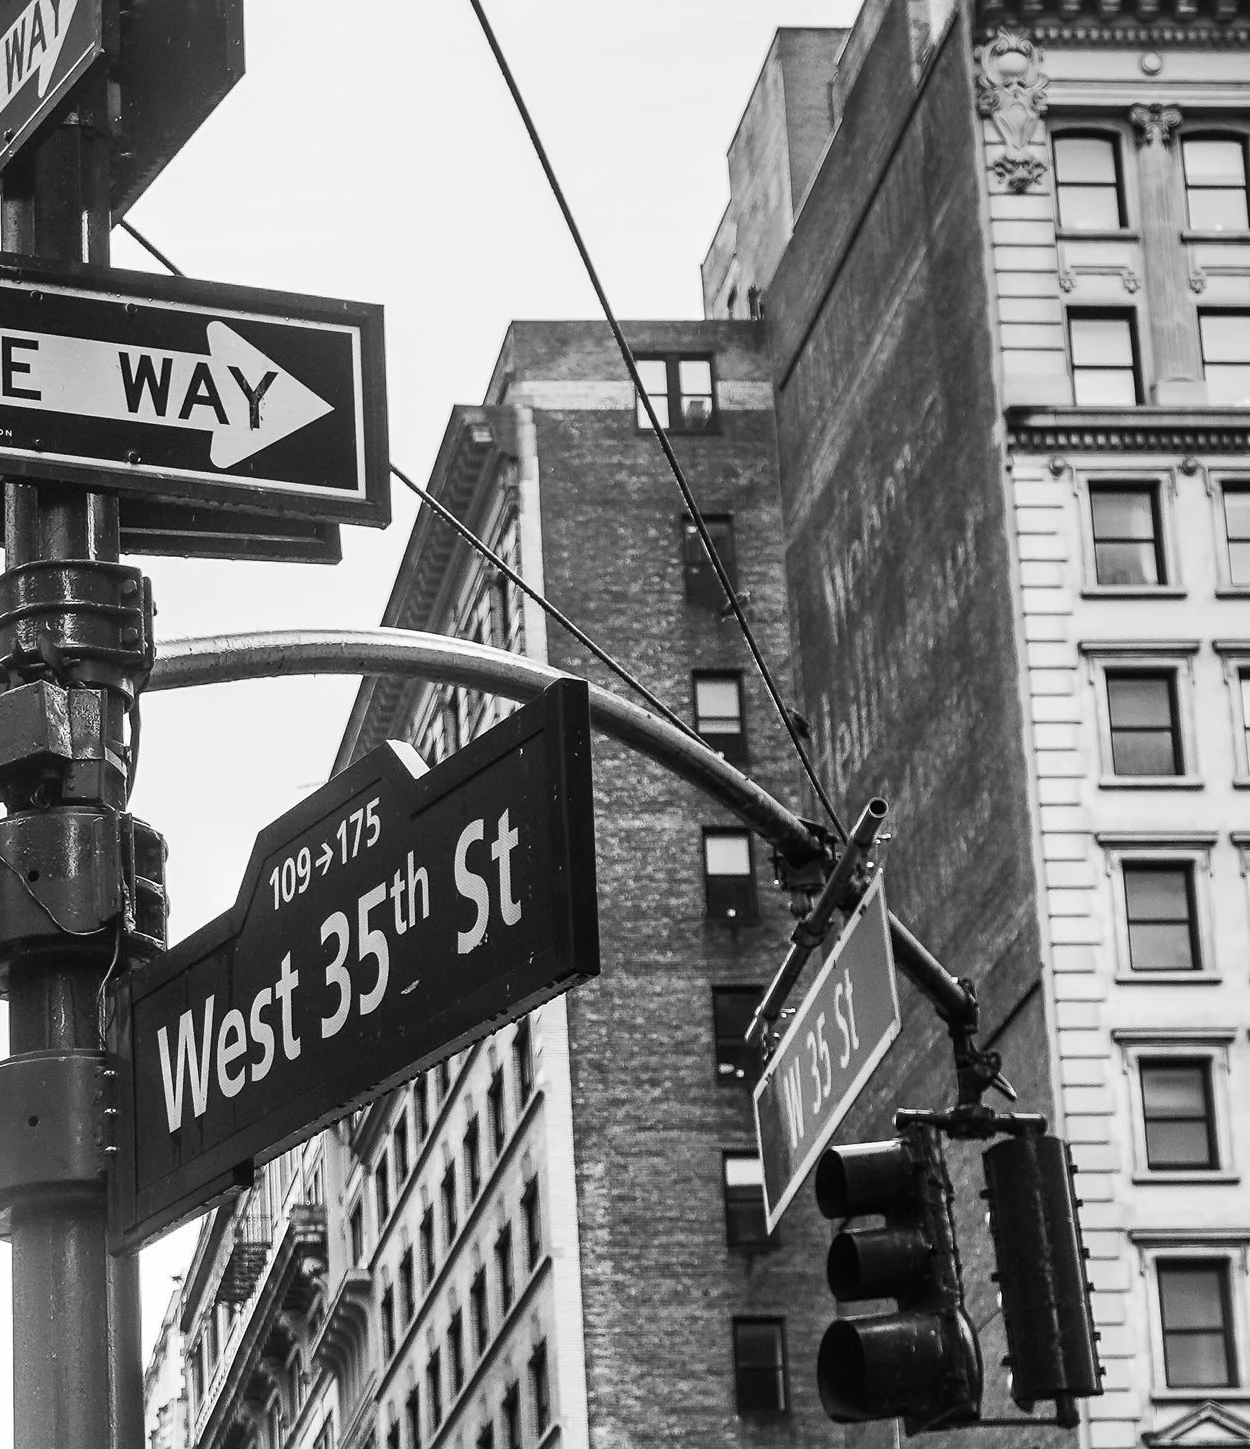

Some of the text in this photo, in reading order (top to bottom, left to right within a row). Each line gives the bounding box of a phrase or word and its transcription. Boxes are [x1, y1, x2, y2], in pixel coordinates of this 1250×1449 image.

[5, 0, 61, 95] WAY
[118, 349, 279, 431] WAY
[269, 796, 382, 910] 109 175
[156, 808, 523, 1134] West 35th St
[783, 967, 860, 1149] W 35 St
